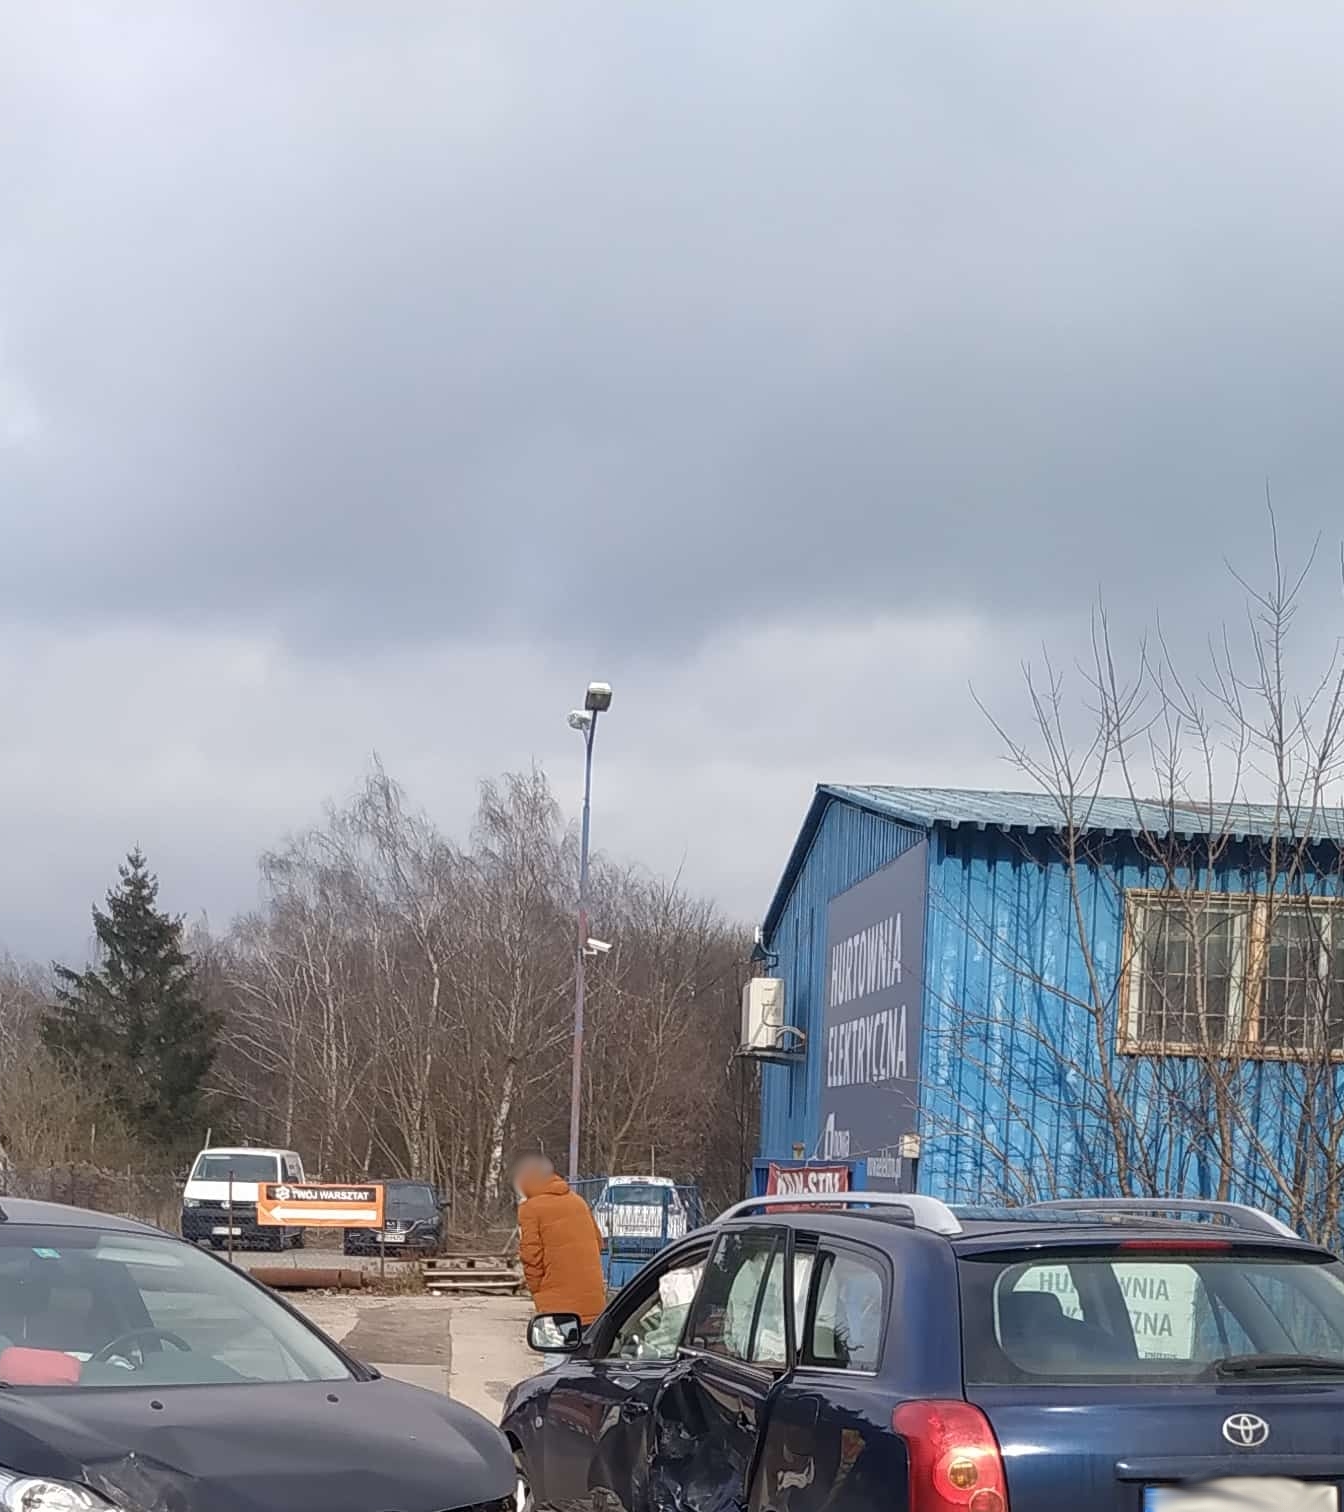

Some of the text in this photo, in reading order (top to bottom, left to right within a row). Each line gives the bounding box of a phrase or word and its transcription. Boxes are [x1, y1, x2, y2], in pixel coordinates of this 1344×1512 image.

[830, 912, 901, 1008] HURTOWNIA
[827, 1005, 906, 1087] ELEKTRYCZNA
[319, 1190, 369, 1200] WARSZTAT
